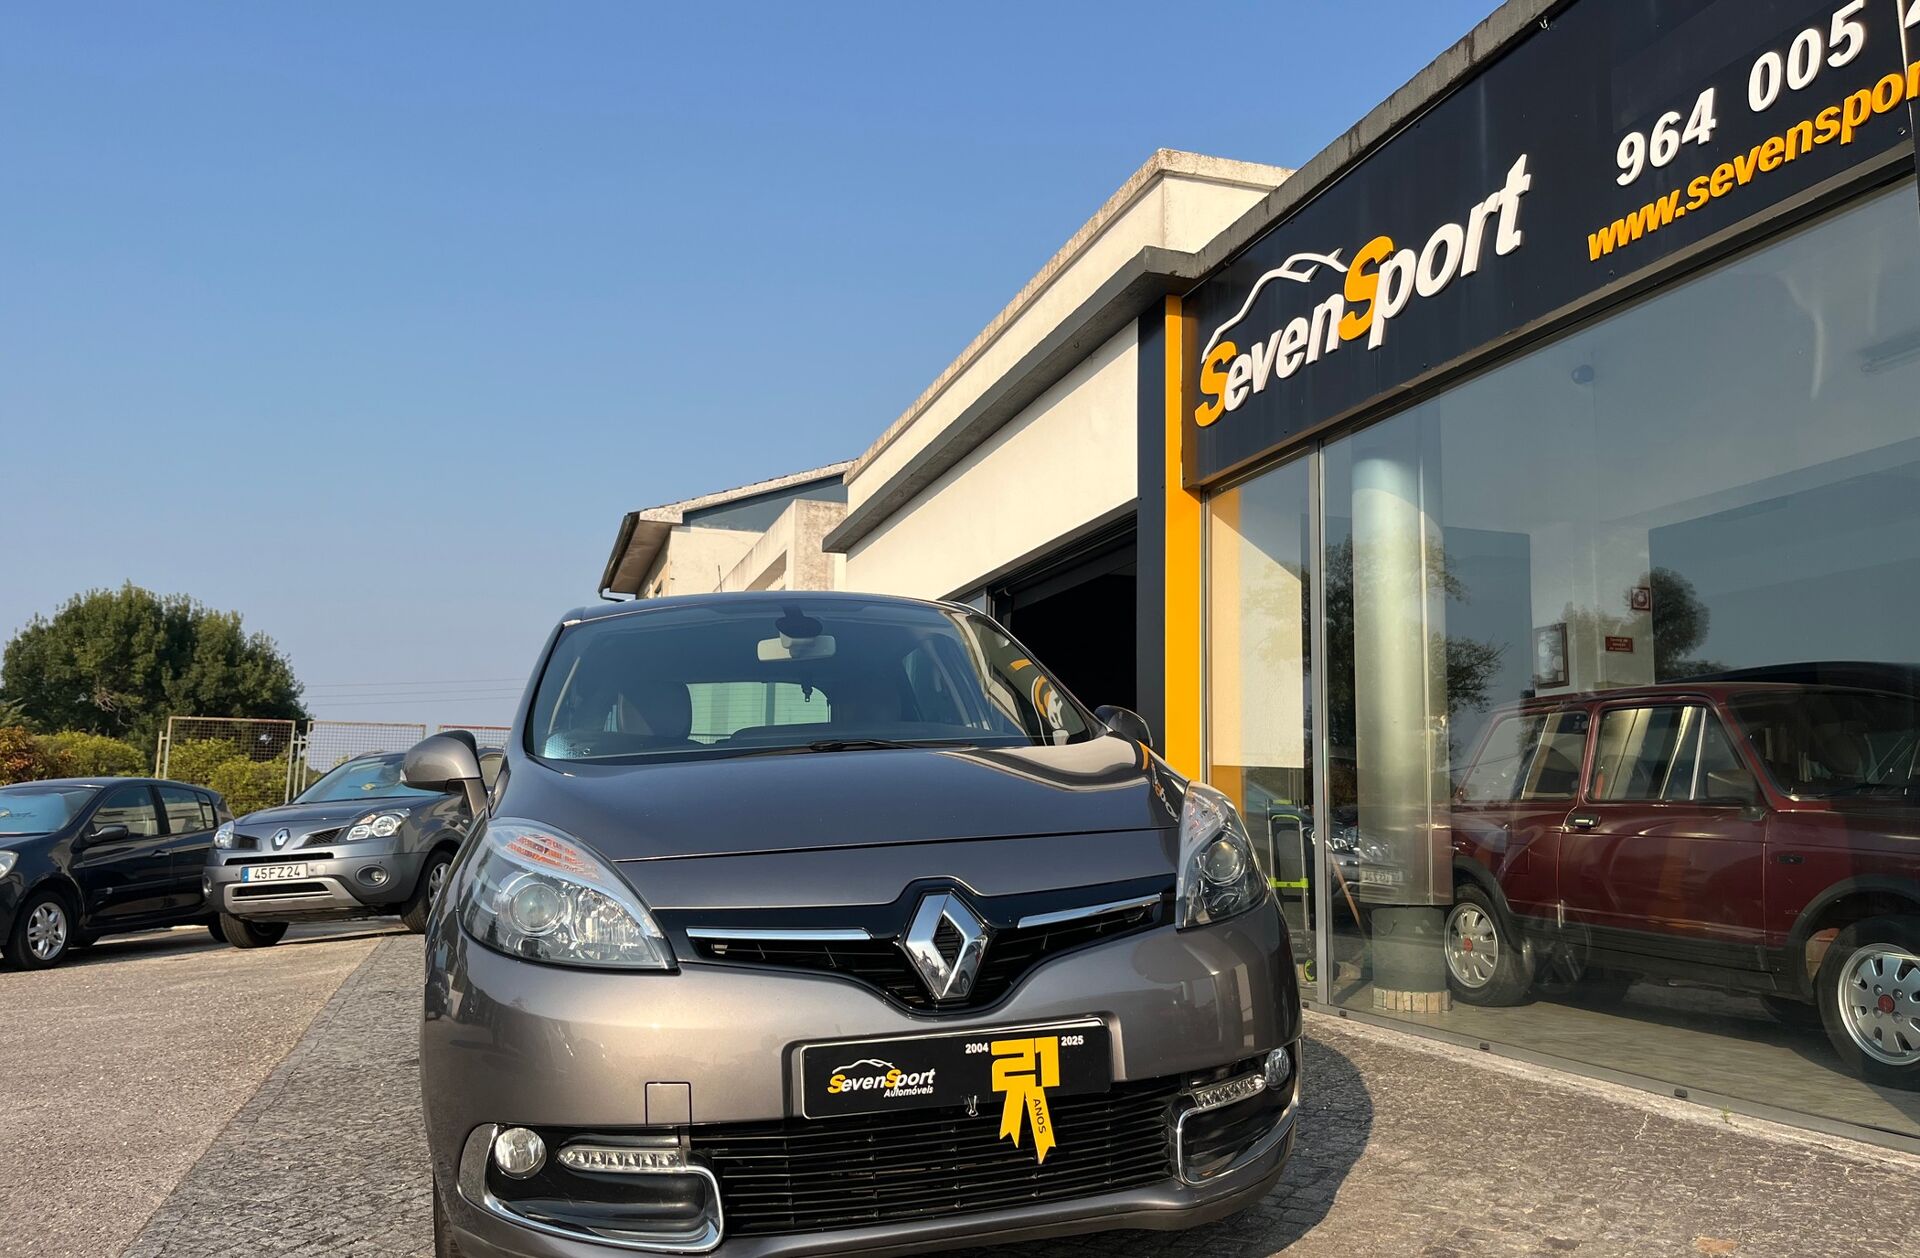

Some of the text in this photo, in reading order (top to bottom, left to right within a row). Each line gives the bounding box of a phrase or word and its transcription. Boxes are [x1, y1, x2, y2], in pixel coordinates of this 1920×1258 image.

[1616, 0, 1865, 187] 964 005
[1194, 154, 1532, 427] SevenSport
[965, 1035, 1085, 1054] 2004 2025
[827, 1068, 936, 1095] SevenSport
[883, 1085, 934, 1099] Automóveis
[1033, 1098, 1047, 1134] ANOS
